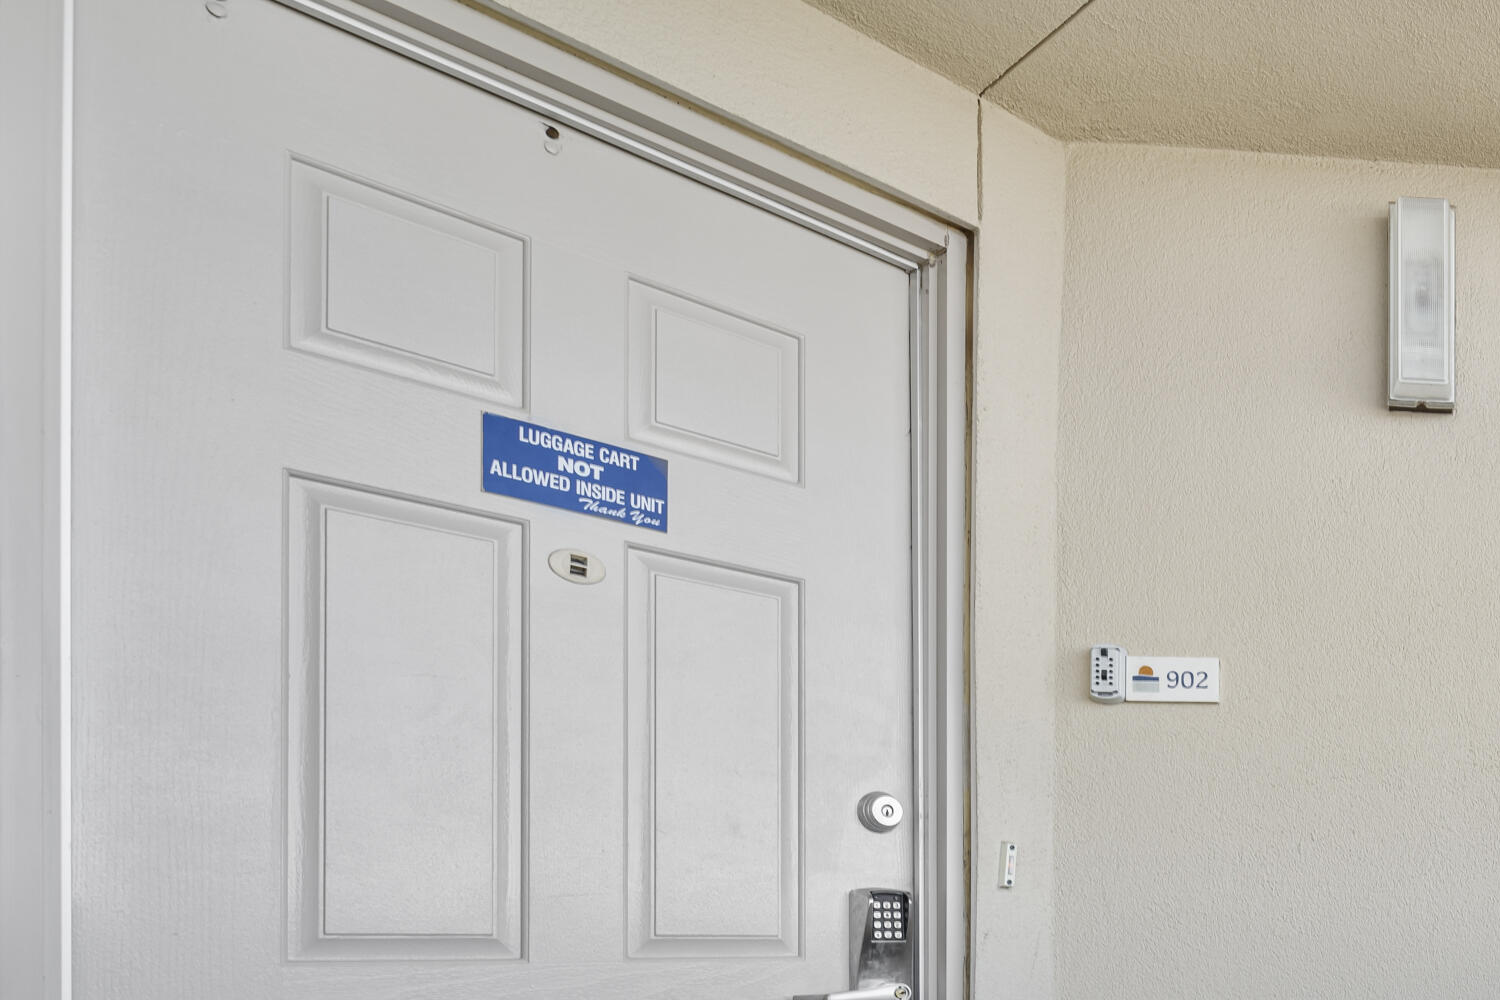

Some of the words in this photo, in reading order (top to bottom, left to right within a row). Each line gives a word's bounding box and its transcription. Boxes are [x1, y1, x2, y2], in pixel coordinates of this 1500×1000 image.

[518, 426, 595, 460] LUGGAGE
[599, 447, 640, 471] CART
[557, 455, 605, 481] NOT
[489, 459, 571, 492] ALLOWED
[576, 479, 625, 505] INSIDE
[630, 492, 665, 514] UNIT
[578, 497, 627, 518] Thank
[629, 510, 661, 526] You
[1166, 670, 1209, 689] 902
